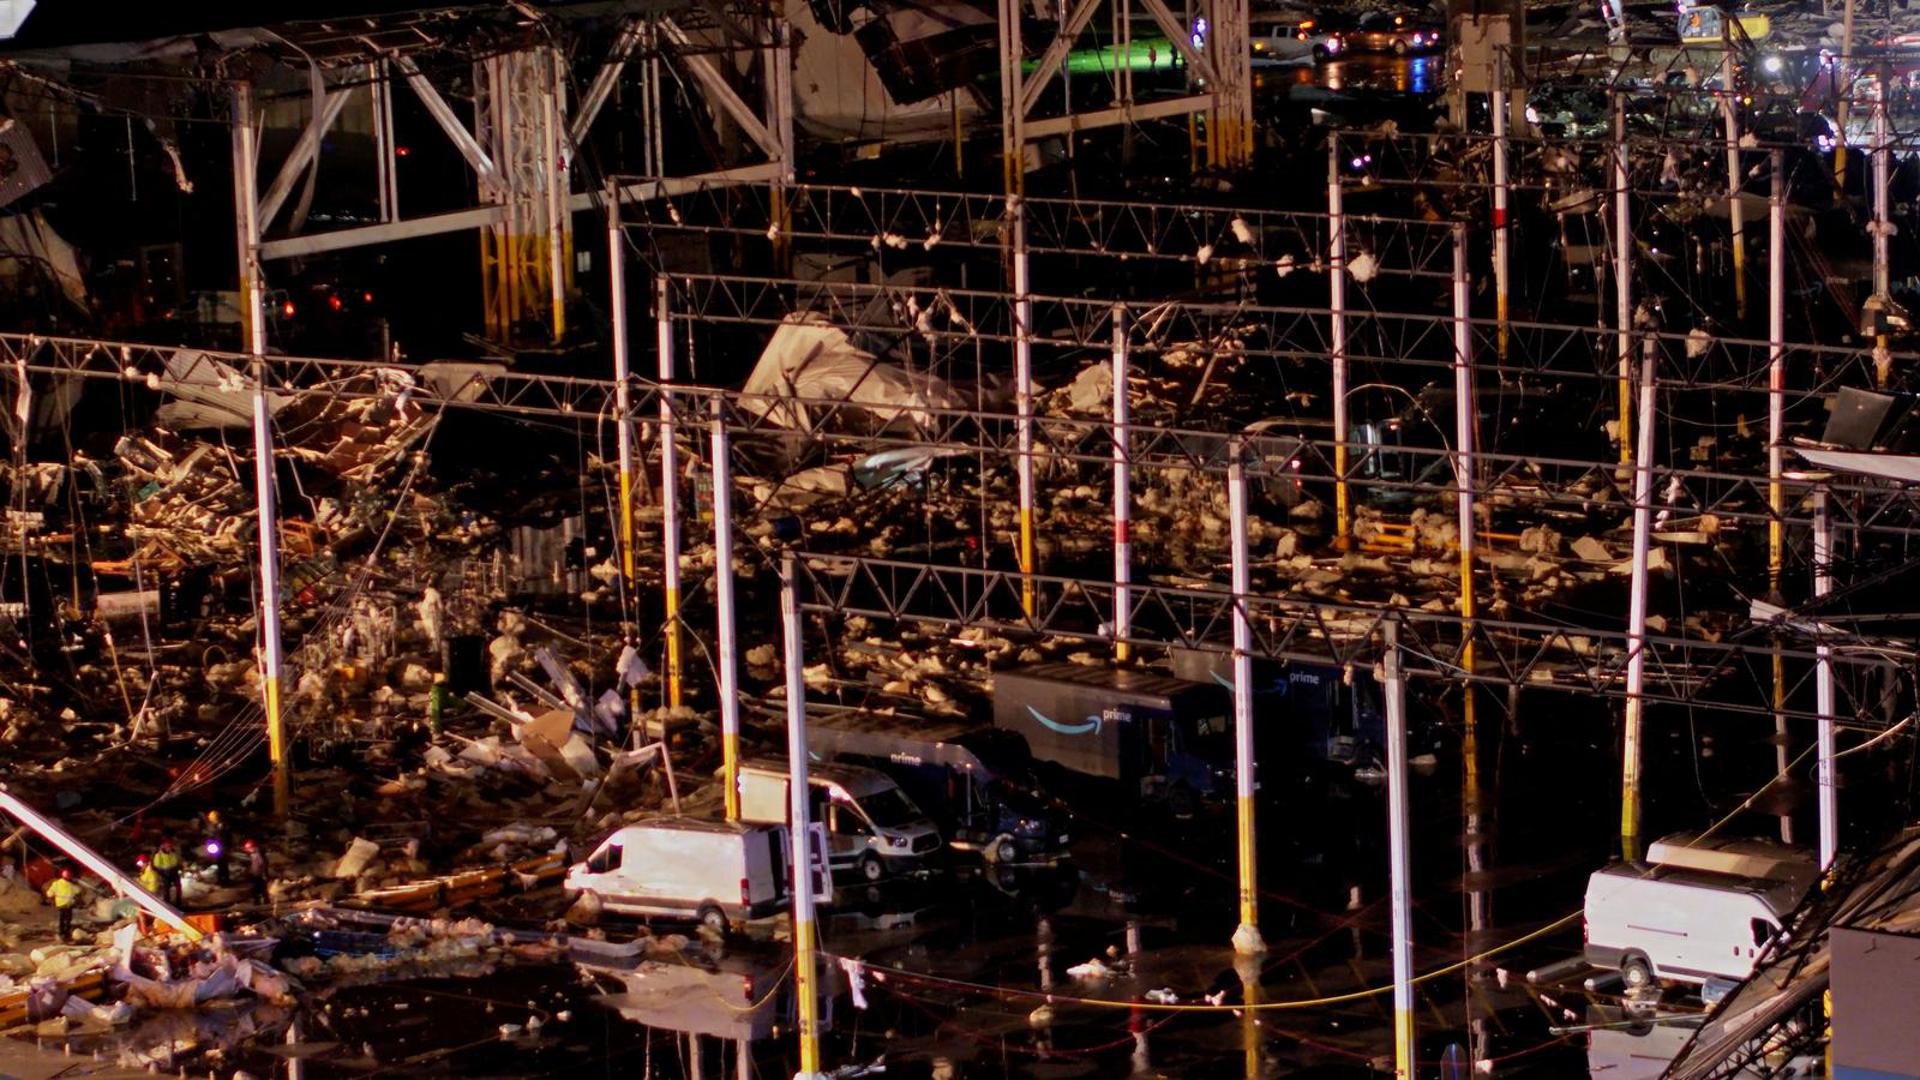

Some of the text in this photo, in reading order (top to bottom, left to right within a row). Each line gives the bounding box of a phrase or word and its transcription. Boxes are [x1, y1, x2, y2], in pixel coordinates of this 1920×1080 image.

[1289, 671, 1319, 684] prime
[1103, 708, 1132, 722] prime
[890, 752, 921, 766] prime
